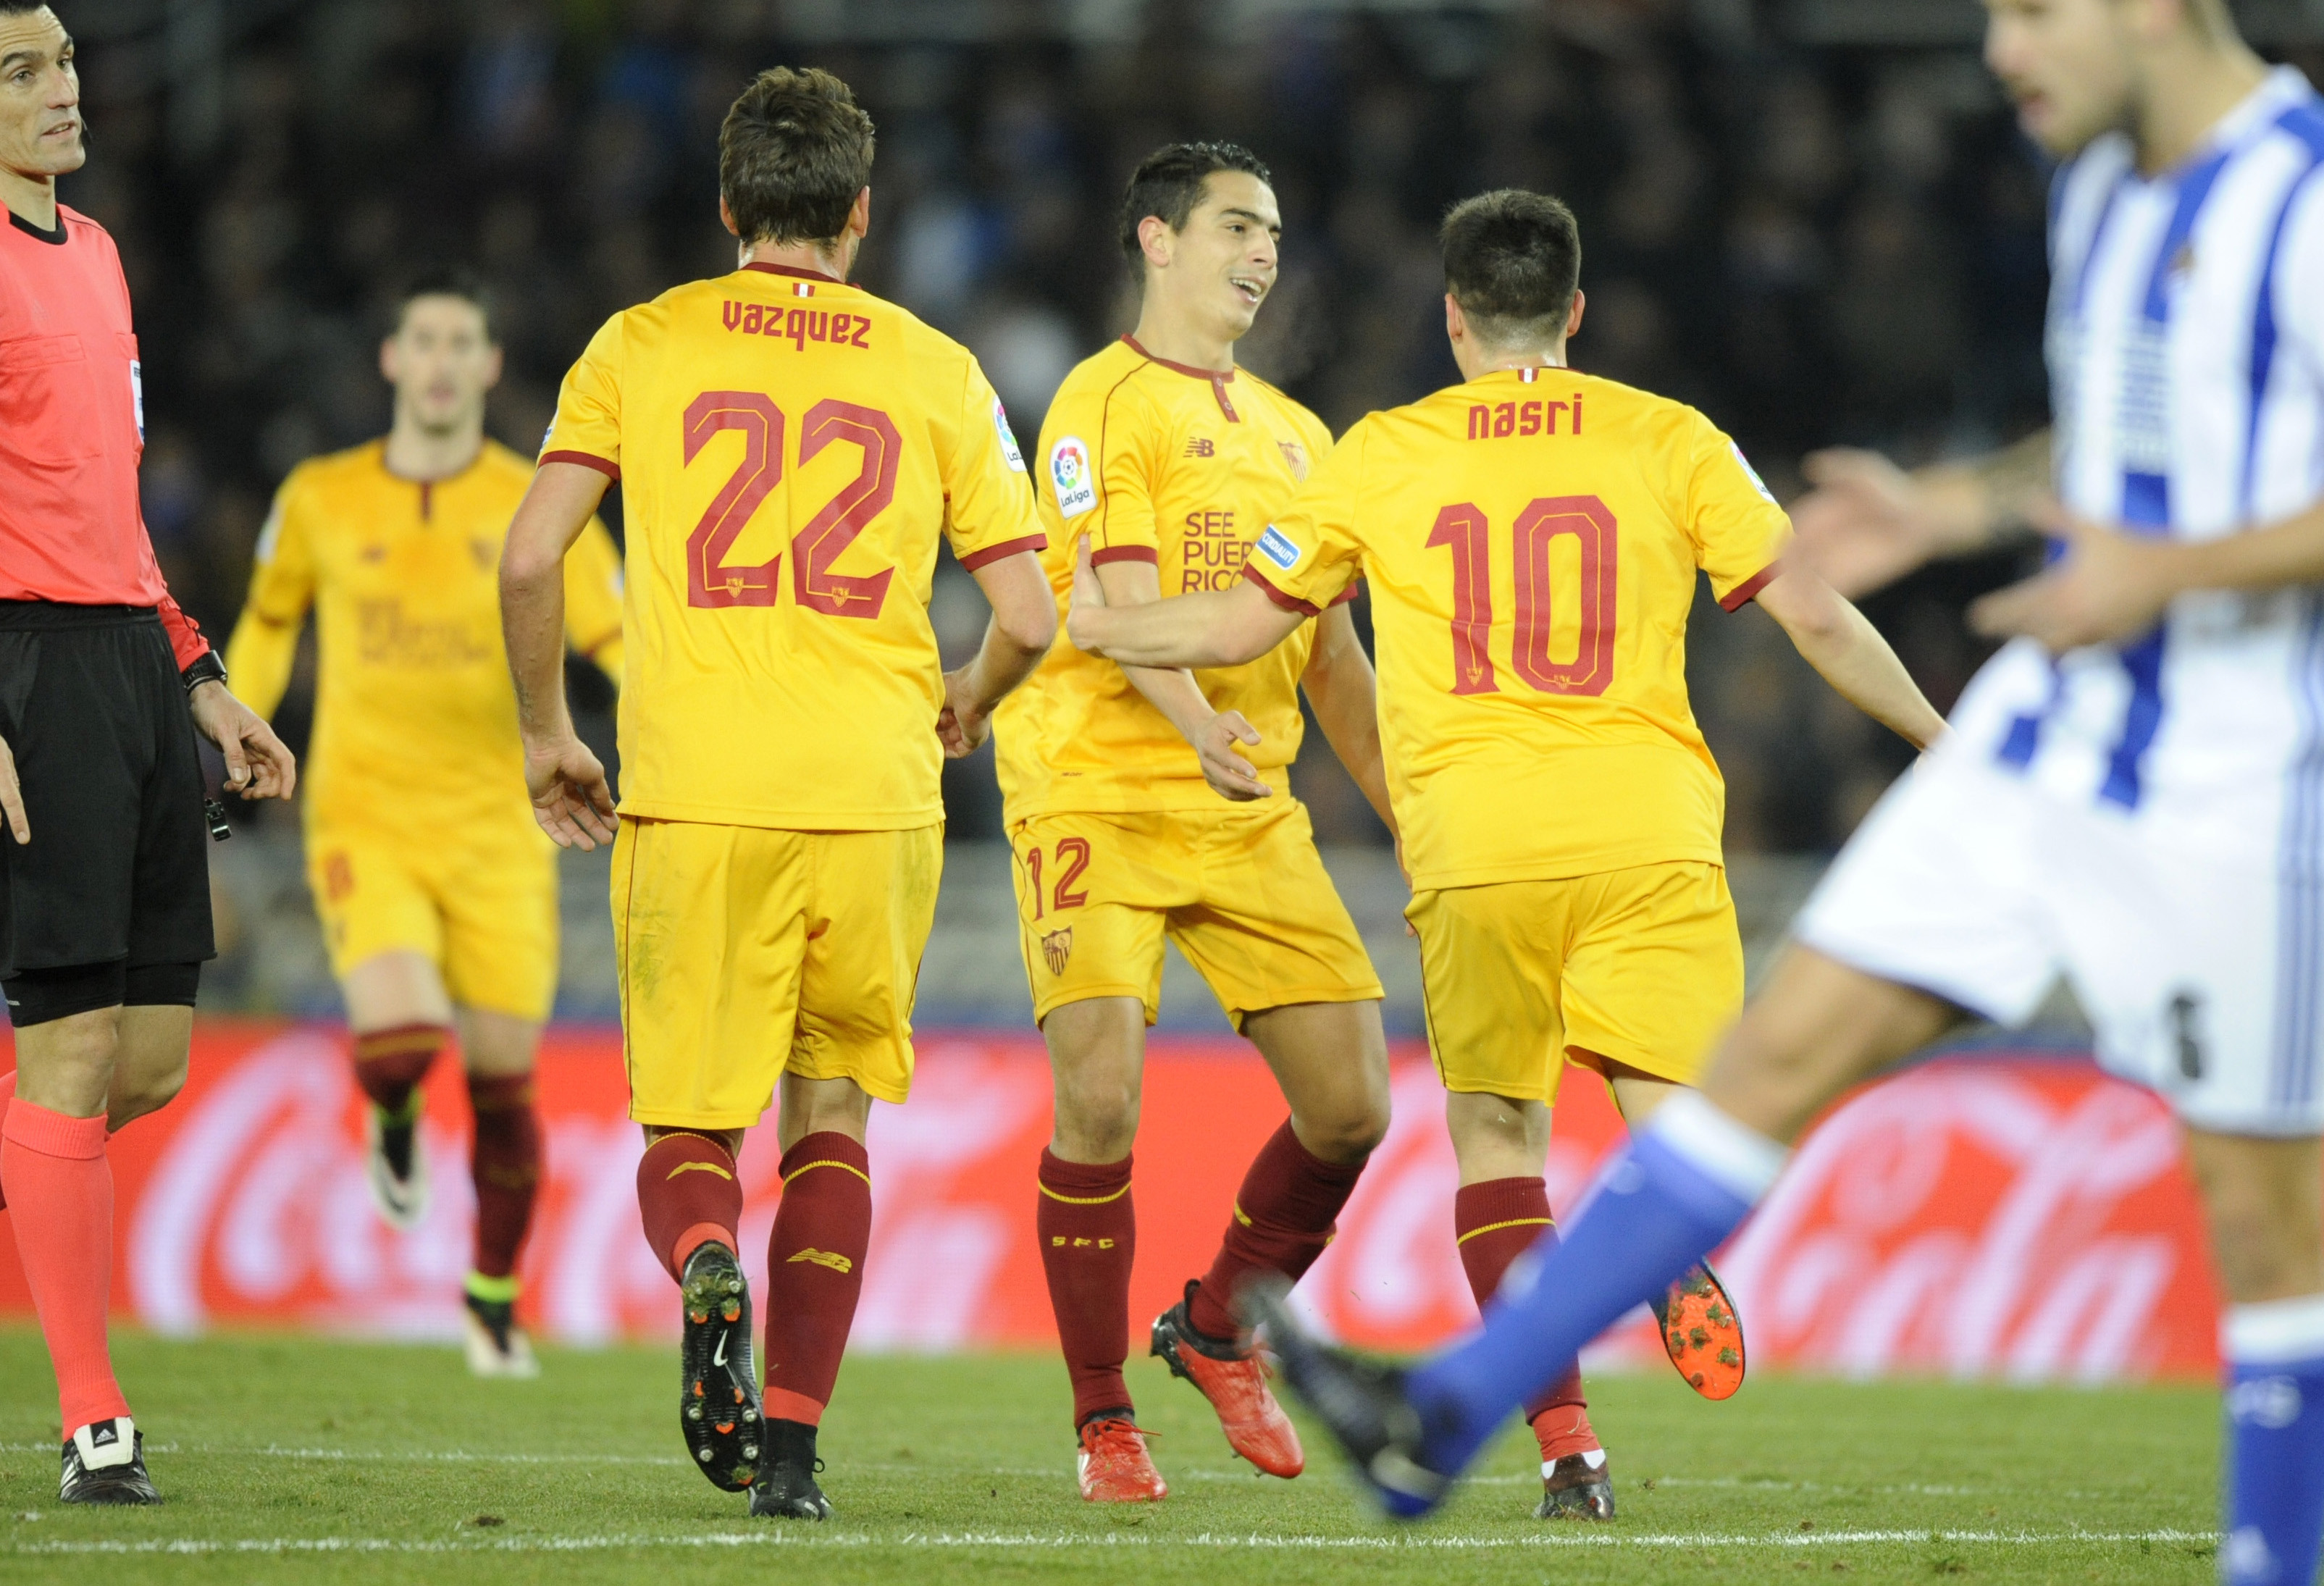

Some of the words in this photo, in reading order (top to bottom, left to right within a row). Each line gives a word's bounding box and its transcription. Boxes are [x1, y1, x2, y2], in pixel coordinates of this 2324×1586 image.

[1468, 393, 1582, 440] nasri
[1007, 450, 1023, 462] LaL
[683, 390, 902, 620] 22
[1060, 489, 1090, 508] LaLiga
[1183, 511, 1236, 537] SEE
[1183, 540, 1254, 567] PUER
[1425, 495, 1617, 697] 10
[1026, 837, 1090, 922] 12
